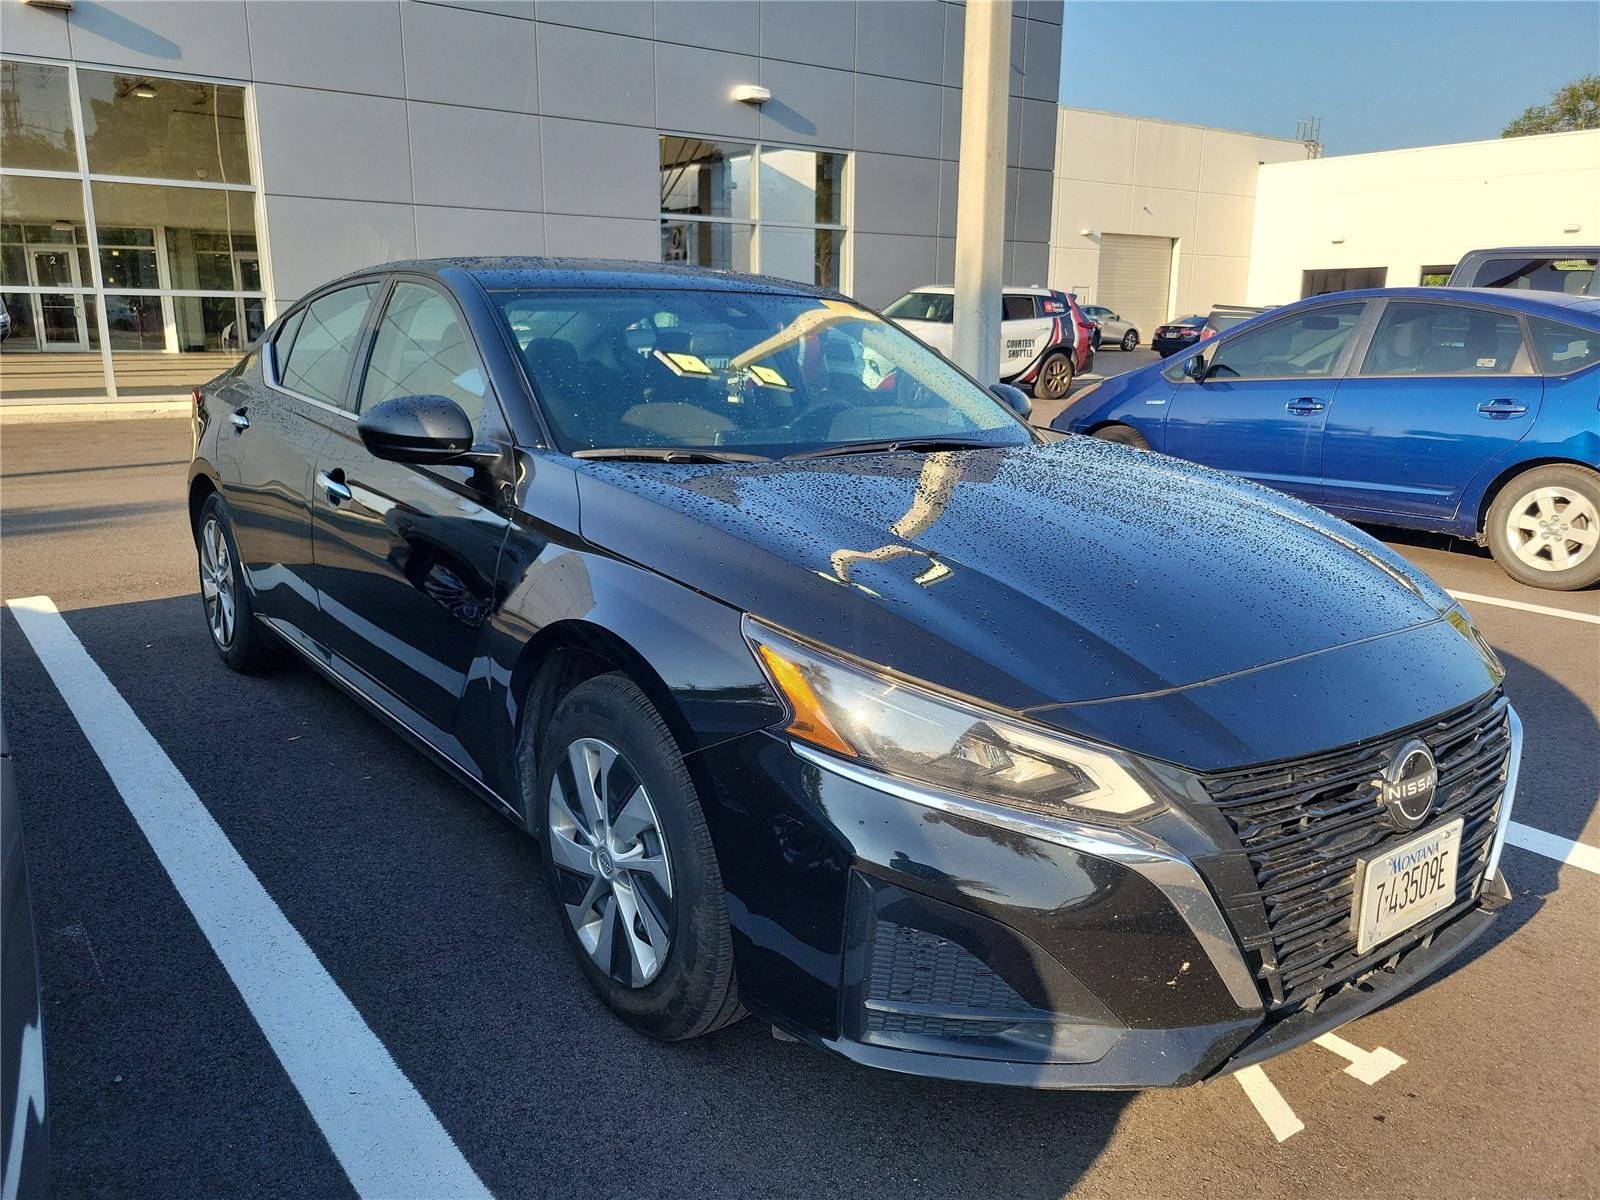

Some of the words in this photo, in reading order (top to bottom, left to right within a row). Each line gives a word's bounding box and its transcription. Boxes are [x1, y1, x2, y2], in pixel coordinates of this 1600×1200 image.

[50, 256, 56, 264] 2
[1006, 339, 1035, 348] COURTESY
[1008, 349, 1033, 358] SHUTTLE
